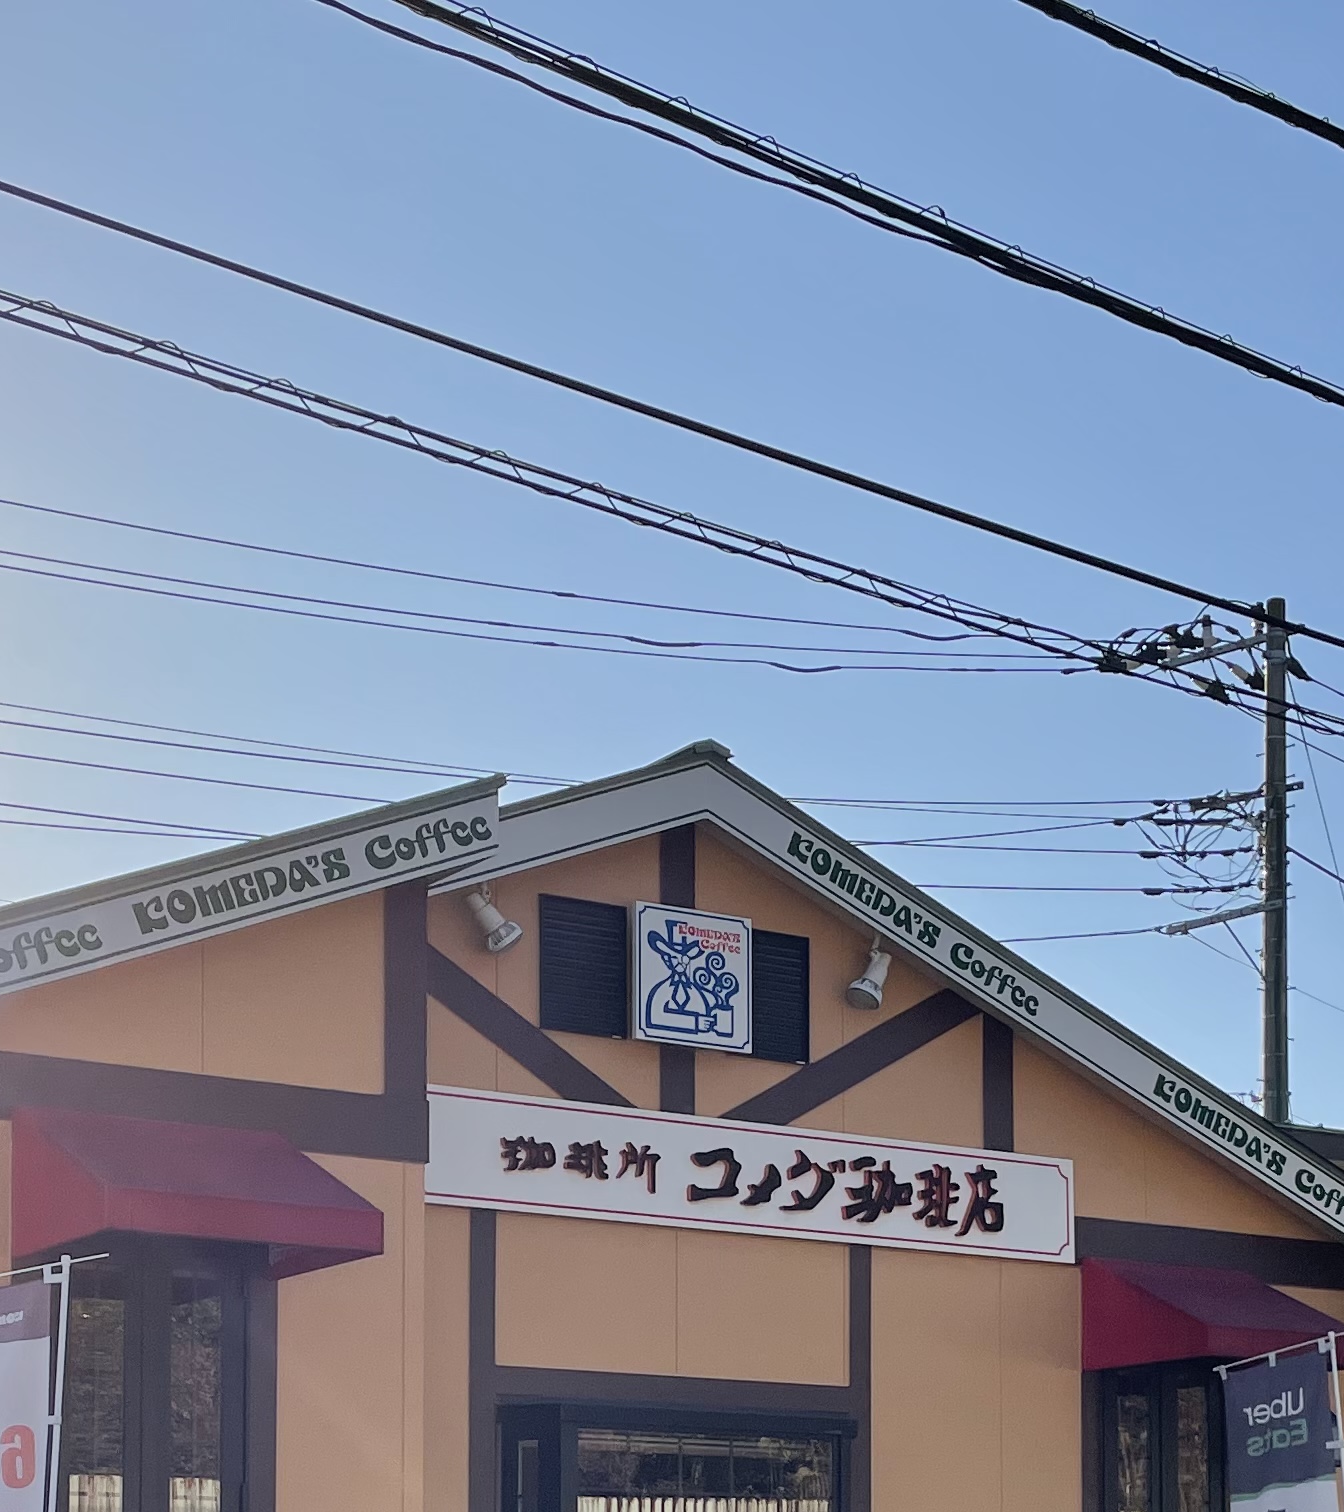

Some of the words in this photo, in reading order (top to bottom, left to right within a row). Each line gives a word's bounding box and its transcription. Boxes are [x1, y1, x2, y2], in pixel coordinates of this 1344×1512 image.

[131, 847, 351, 935] KOMEDA'S
[364, 815, 493, 870] Coffee
[786, 830, 942, 948] KOMEDA'S
[949, 942, 1040, 1017] Coffee
[700, 939, 741, 955] Coffee
[1152, 1073, 1287, 1180] KOMEDA'S
[499, 1135, 662, 1195] 珈琲所
[686, 1146, 1005, 1237] コメダ珈琲店
